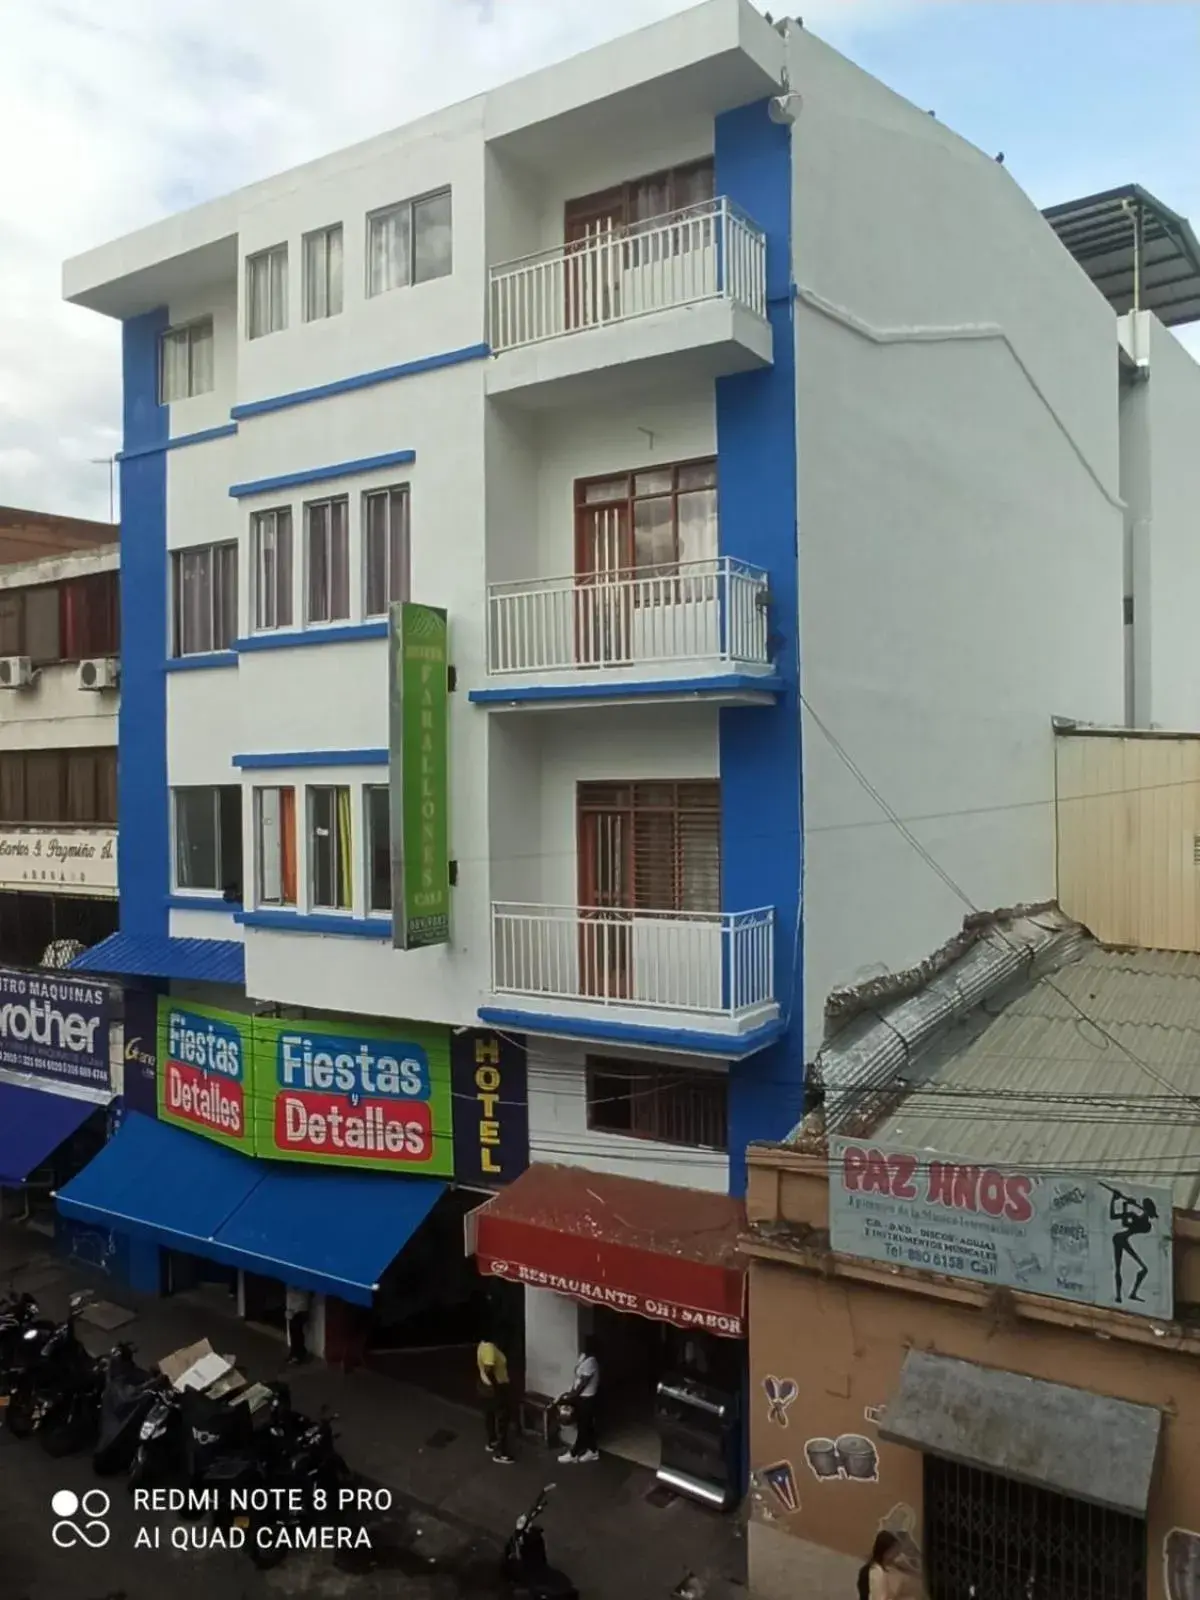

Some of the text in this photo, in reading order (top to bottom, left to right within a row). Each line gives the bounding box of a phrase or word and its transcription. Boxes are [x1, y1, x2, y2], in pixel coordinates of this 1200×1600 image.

[22, 869, 85, 882] ABOGAO
[0, 976, 103, 1005] TRO MAQUINAS
[0, 998, 100, 1054] rother
[169, 1013, 240, 1077] Fiestas
[282, 1036, 422, 1095] Fiestas
[170, 1067, 240, 1131] Detalles
[285, 1098, 424, 1154] Detalles
[351, 1093, 359, 1106] y
[475, 1039, 501, 1173] HOTEL
[970, 1259, 998, 1276] Cali
[517, 1264, 639, 1309] RESTAURANTE
[681, 1308, 742, 1334] SABOR
